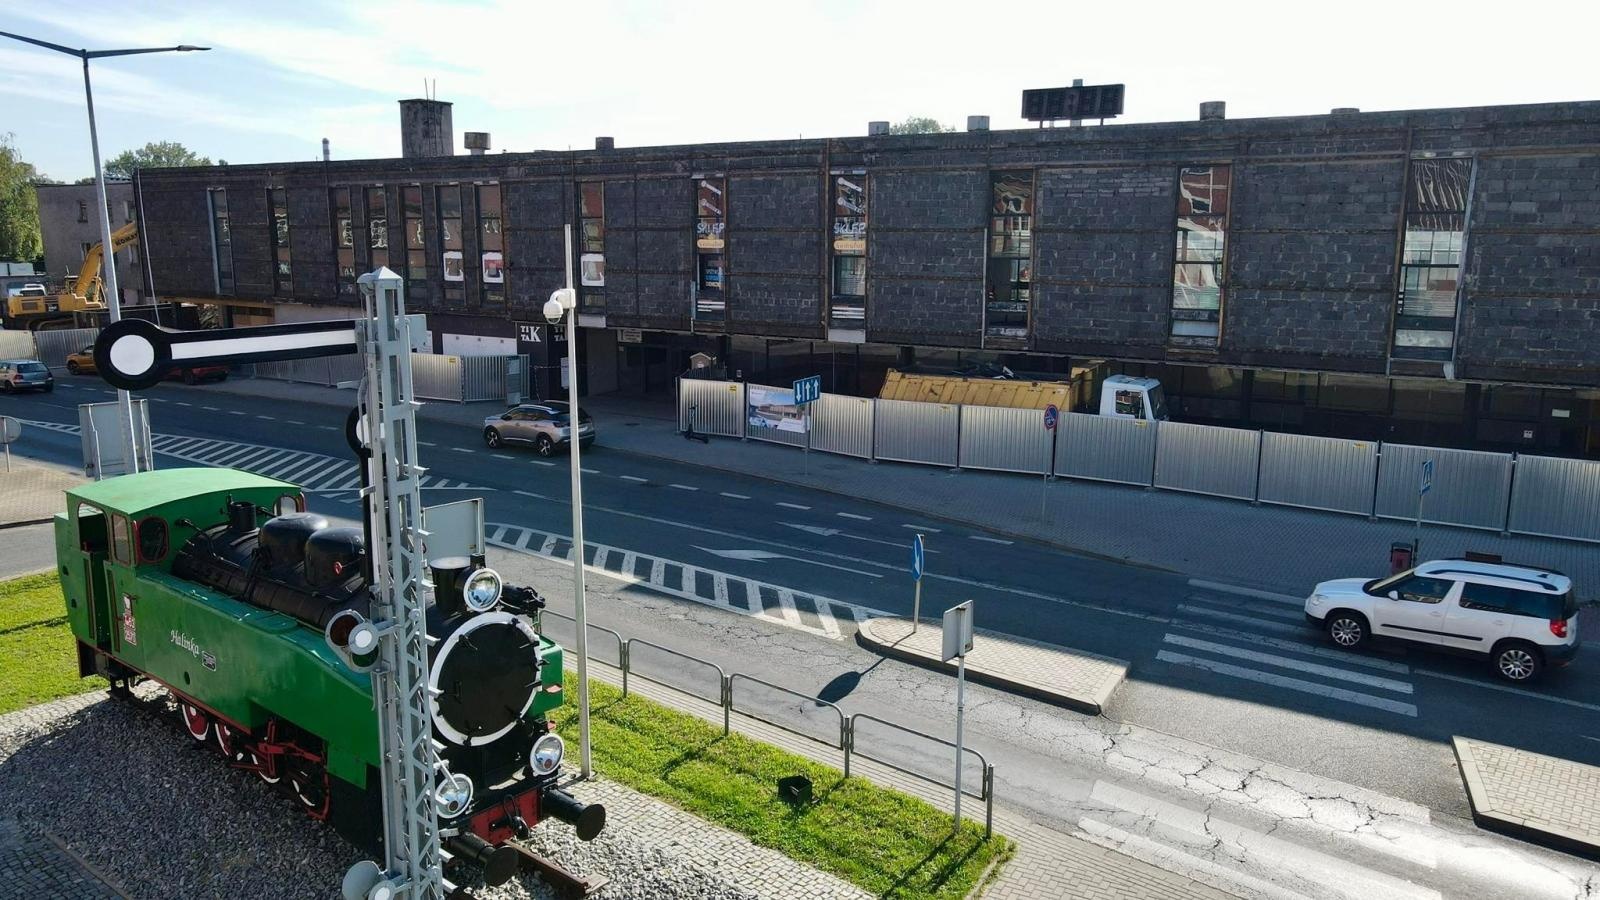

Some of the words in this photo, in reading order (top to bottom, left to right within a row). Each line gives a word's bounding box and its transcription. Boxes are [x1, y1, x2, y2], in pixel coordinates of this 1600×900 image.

[697, 222, 724, 234] SKLEP
[834, 222, 866, 234] SKLEP
[170, 629, 199, 657] Halinka
